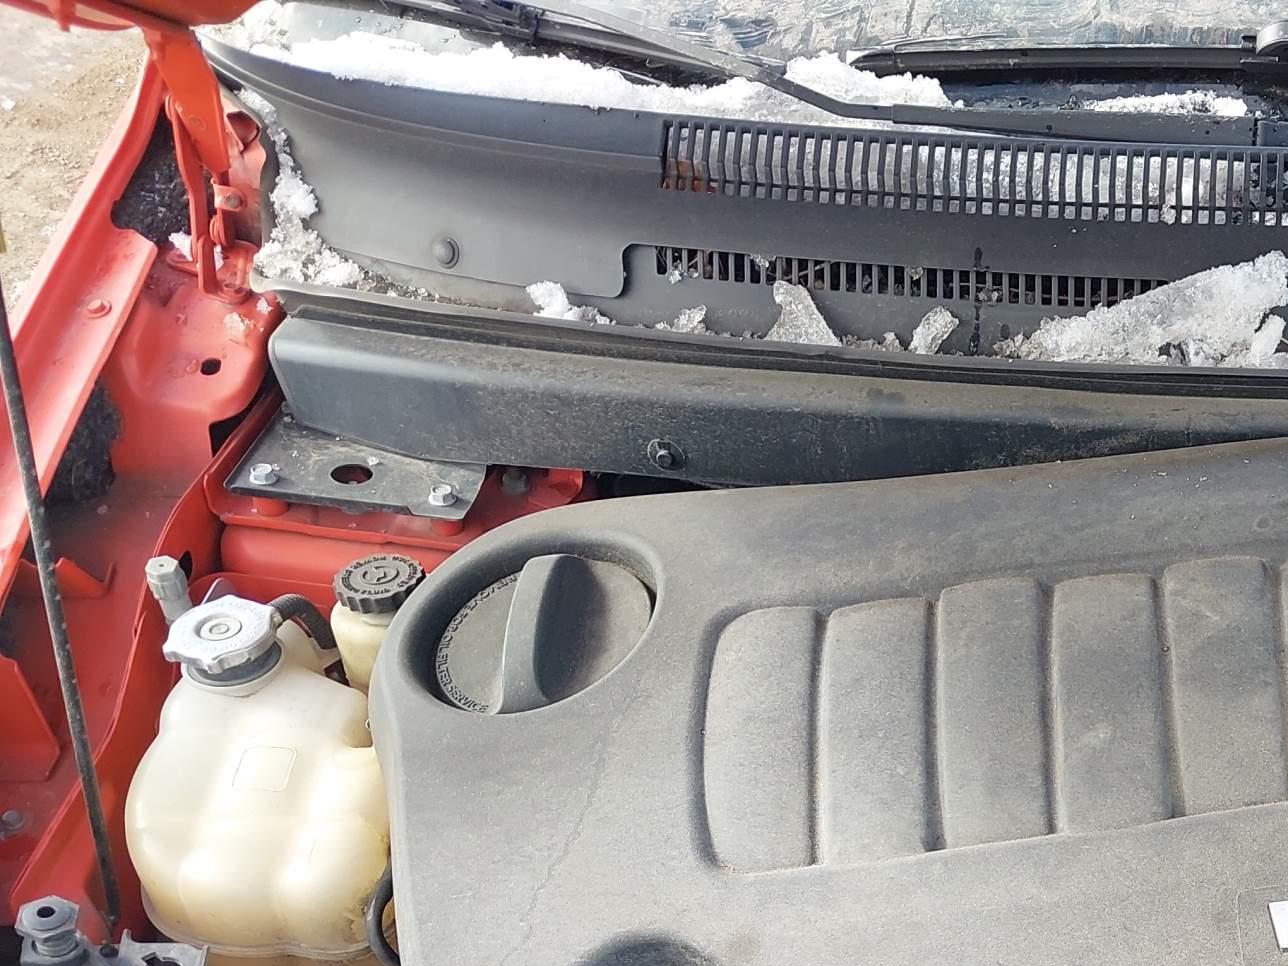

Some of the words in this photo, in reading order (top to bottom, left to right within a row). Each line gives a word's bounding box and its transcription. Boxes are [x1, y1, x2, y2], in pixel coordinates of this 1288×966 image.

[439, 634, 454, 653] OIL
[437, 653, 452, 687] FILTER
[447, 685, 489, 714] SERVICE
